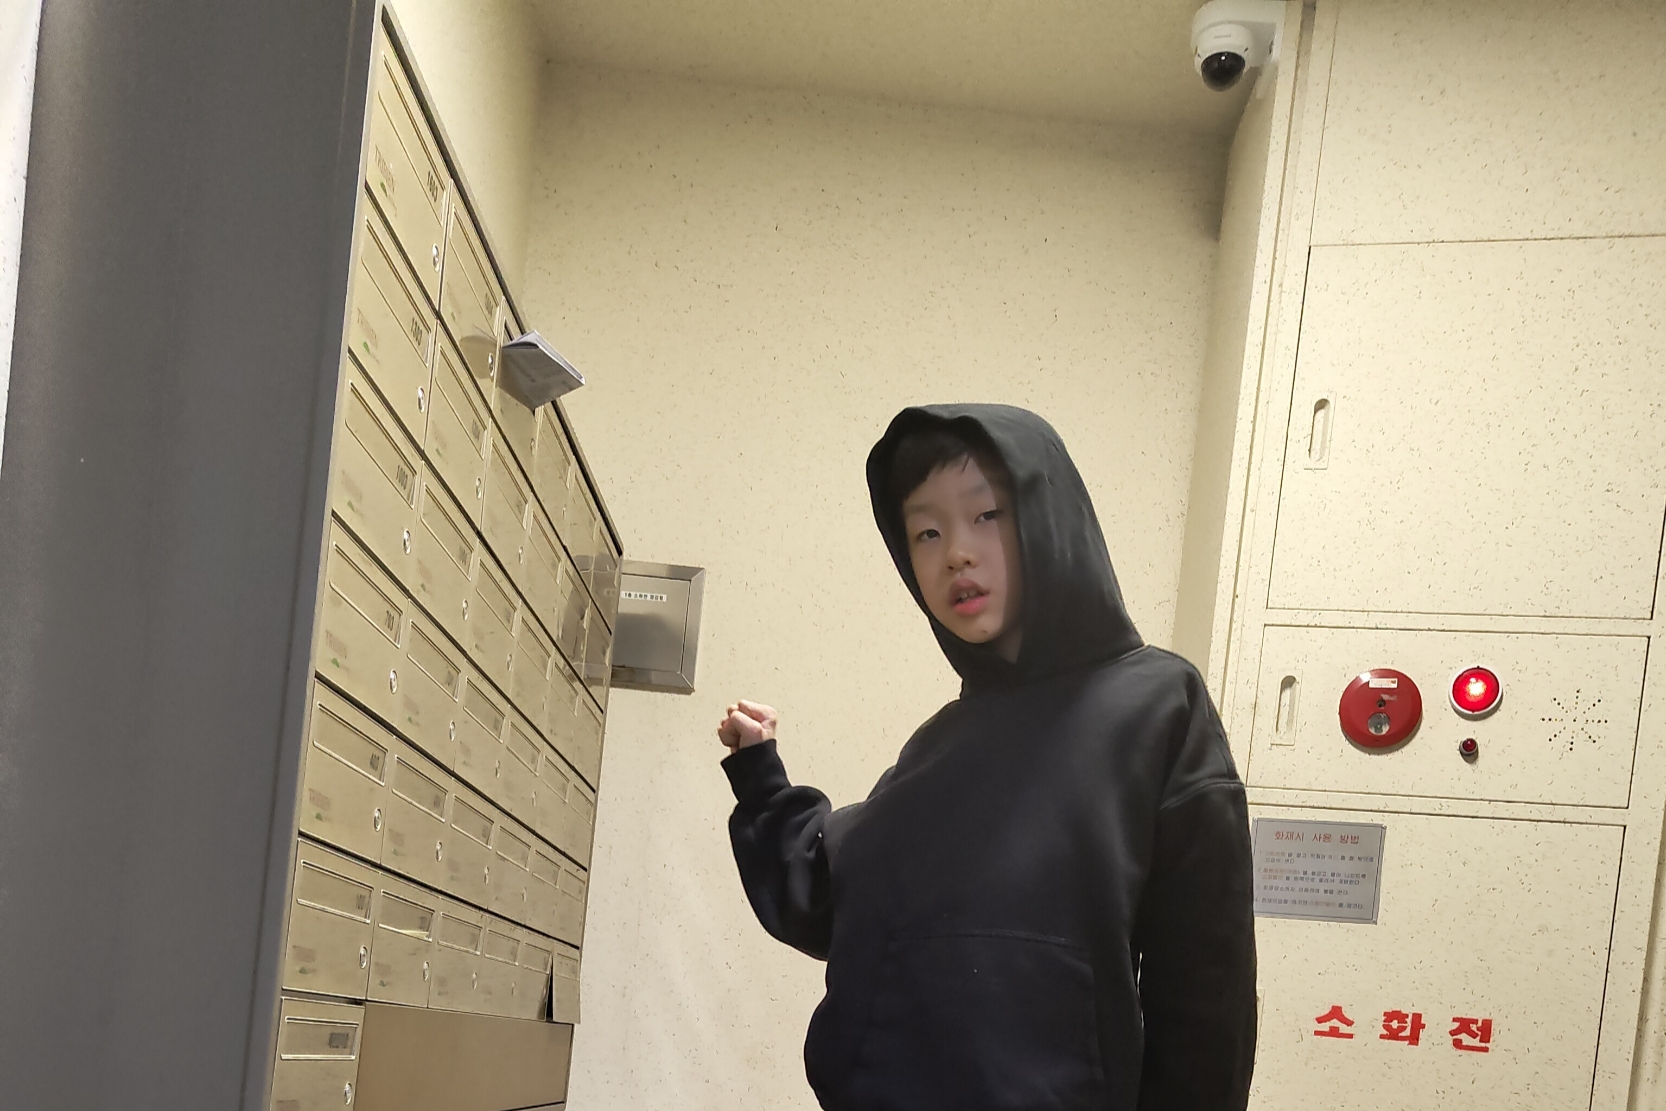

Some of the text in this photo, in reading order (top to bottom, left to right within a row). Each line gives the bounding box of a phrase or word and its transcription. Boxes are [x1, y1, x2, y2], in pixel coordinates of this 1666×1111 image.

[1274, 830, 1360, 845] 화재시 사용 방법
[1314, 1005, 1493, 1053] 소화전
